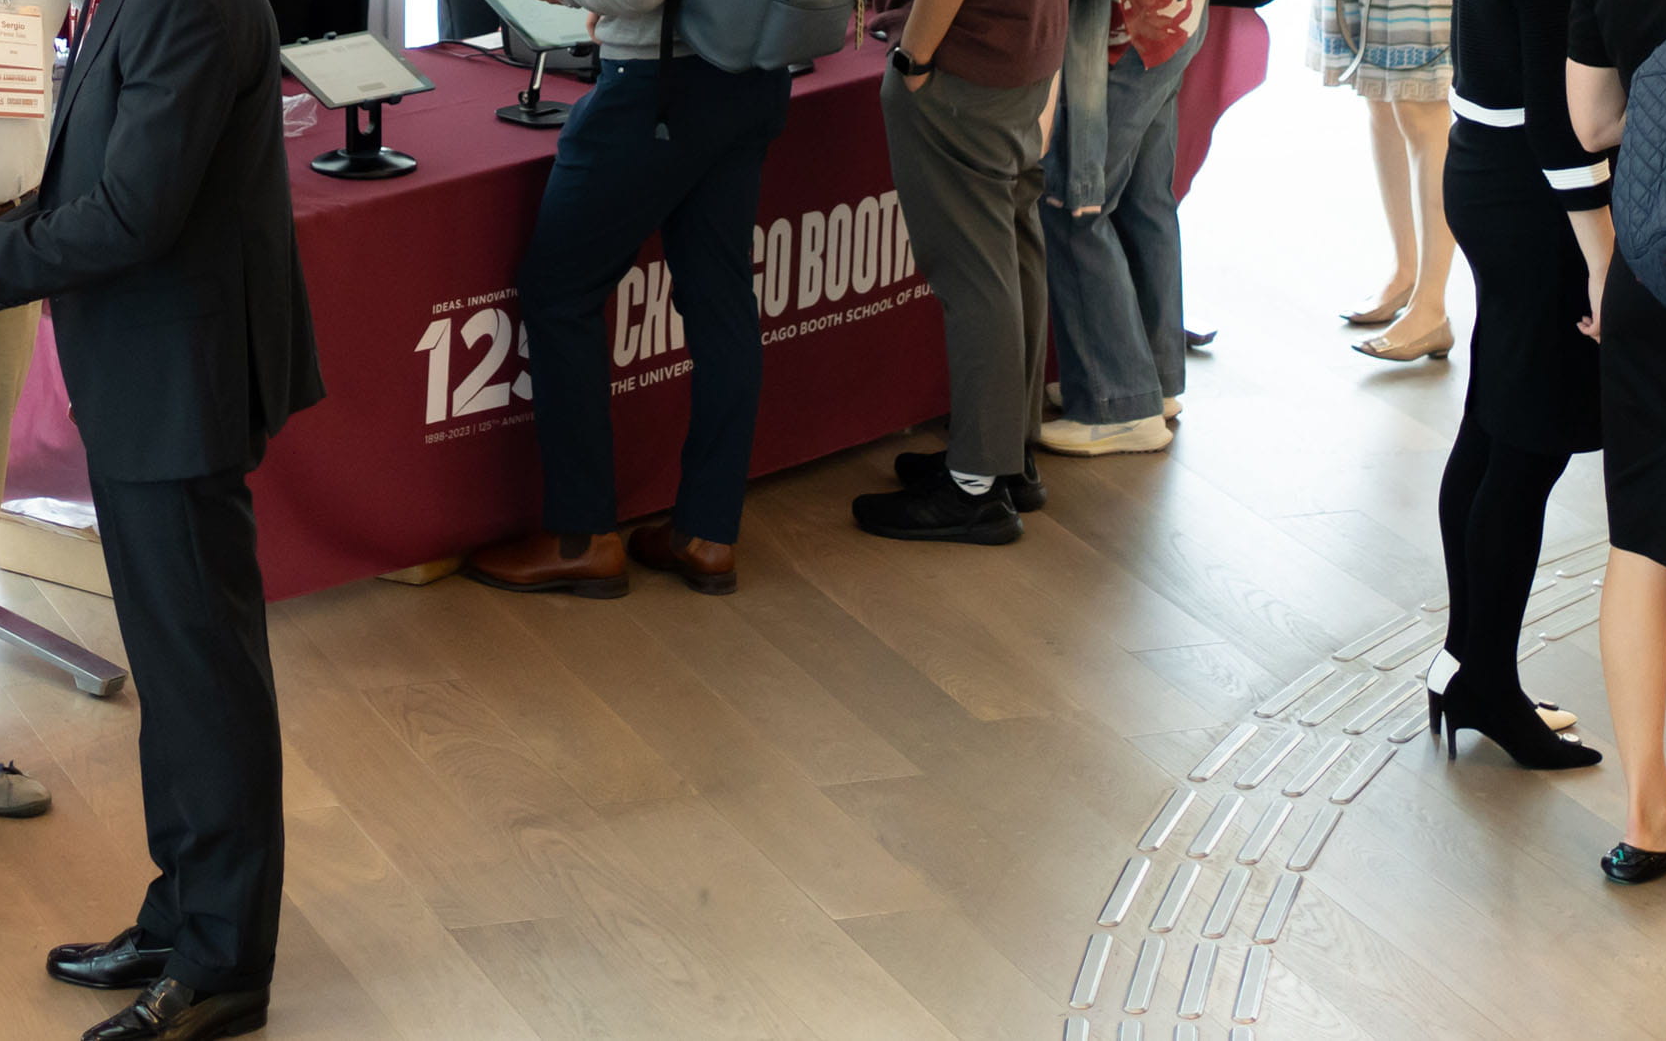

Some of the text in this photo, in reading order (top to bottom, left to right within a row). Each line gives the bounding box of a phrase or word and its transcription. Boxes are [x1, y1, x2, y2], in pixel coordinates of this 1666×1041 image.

[1, 20, 26, 31] Sergio
[797, 189, 915, 310] BOOTH
[432, 299, 464, 315] IDEAS.
[611, 376, 636, 396] THE
[800, 312, 843, 335] BOOTH
[845, 296, 894, 323] SCHOOL
[896, 289, 913, 306] OF
[425, 425, 470, 444] 1898-2023
